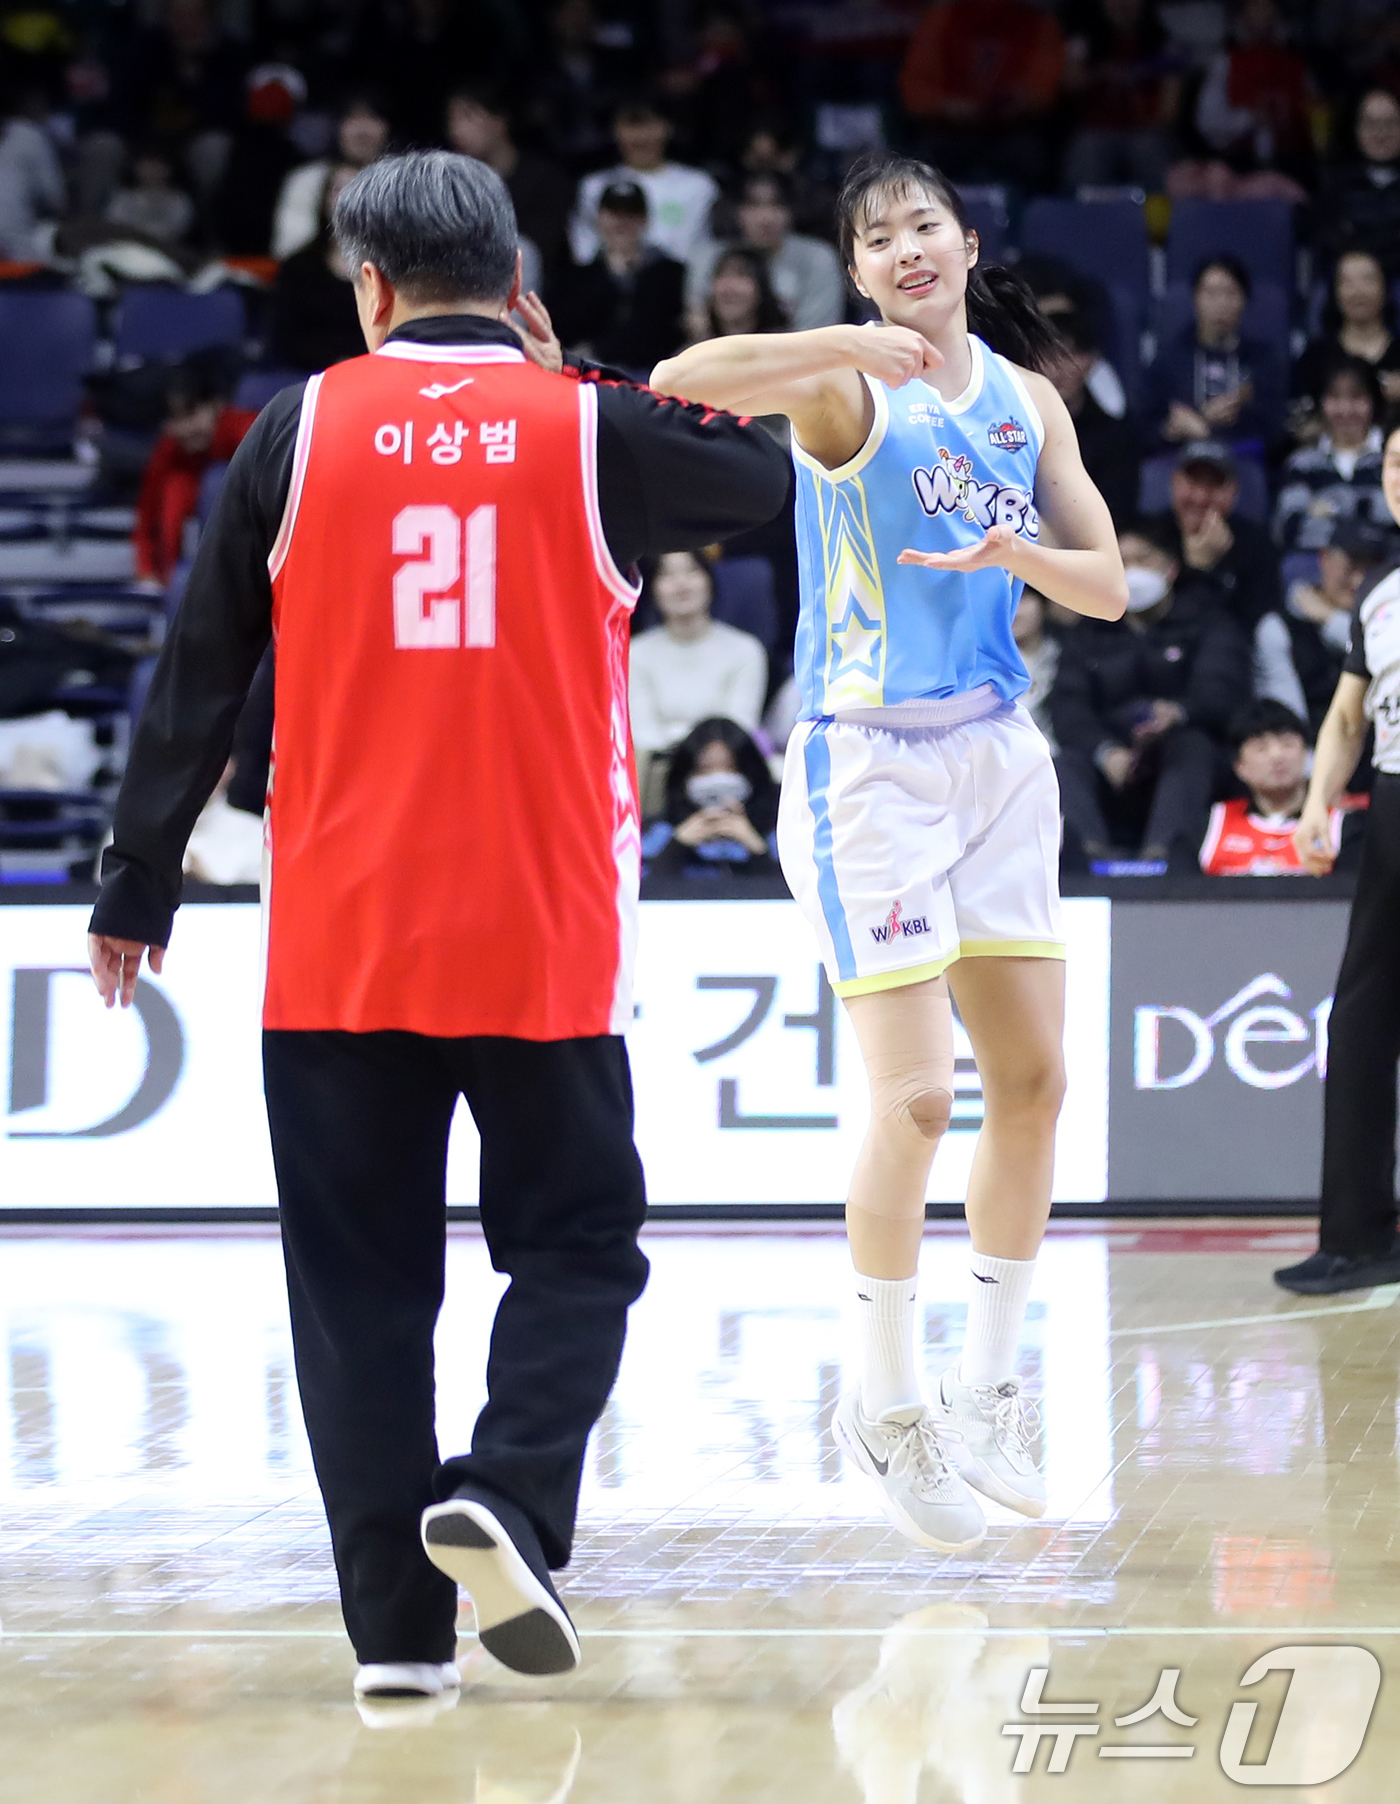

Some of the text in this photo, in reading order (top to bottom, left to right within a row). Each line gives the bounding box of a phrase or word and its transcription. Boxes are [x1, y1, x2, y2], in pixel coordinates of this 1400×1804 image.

[908, 403, 940, 415] EDIYA
[908, 414, 944, 428] COFEE
[374, 419, 517, 465] 이상범
[990, 430, 1026, 445] ALL STAR
[392, 504, 497, 649] 21
[870, 917, 931, 943] WKBL
